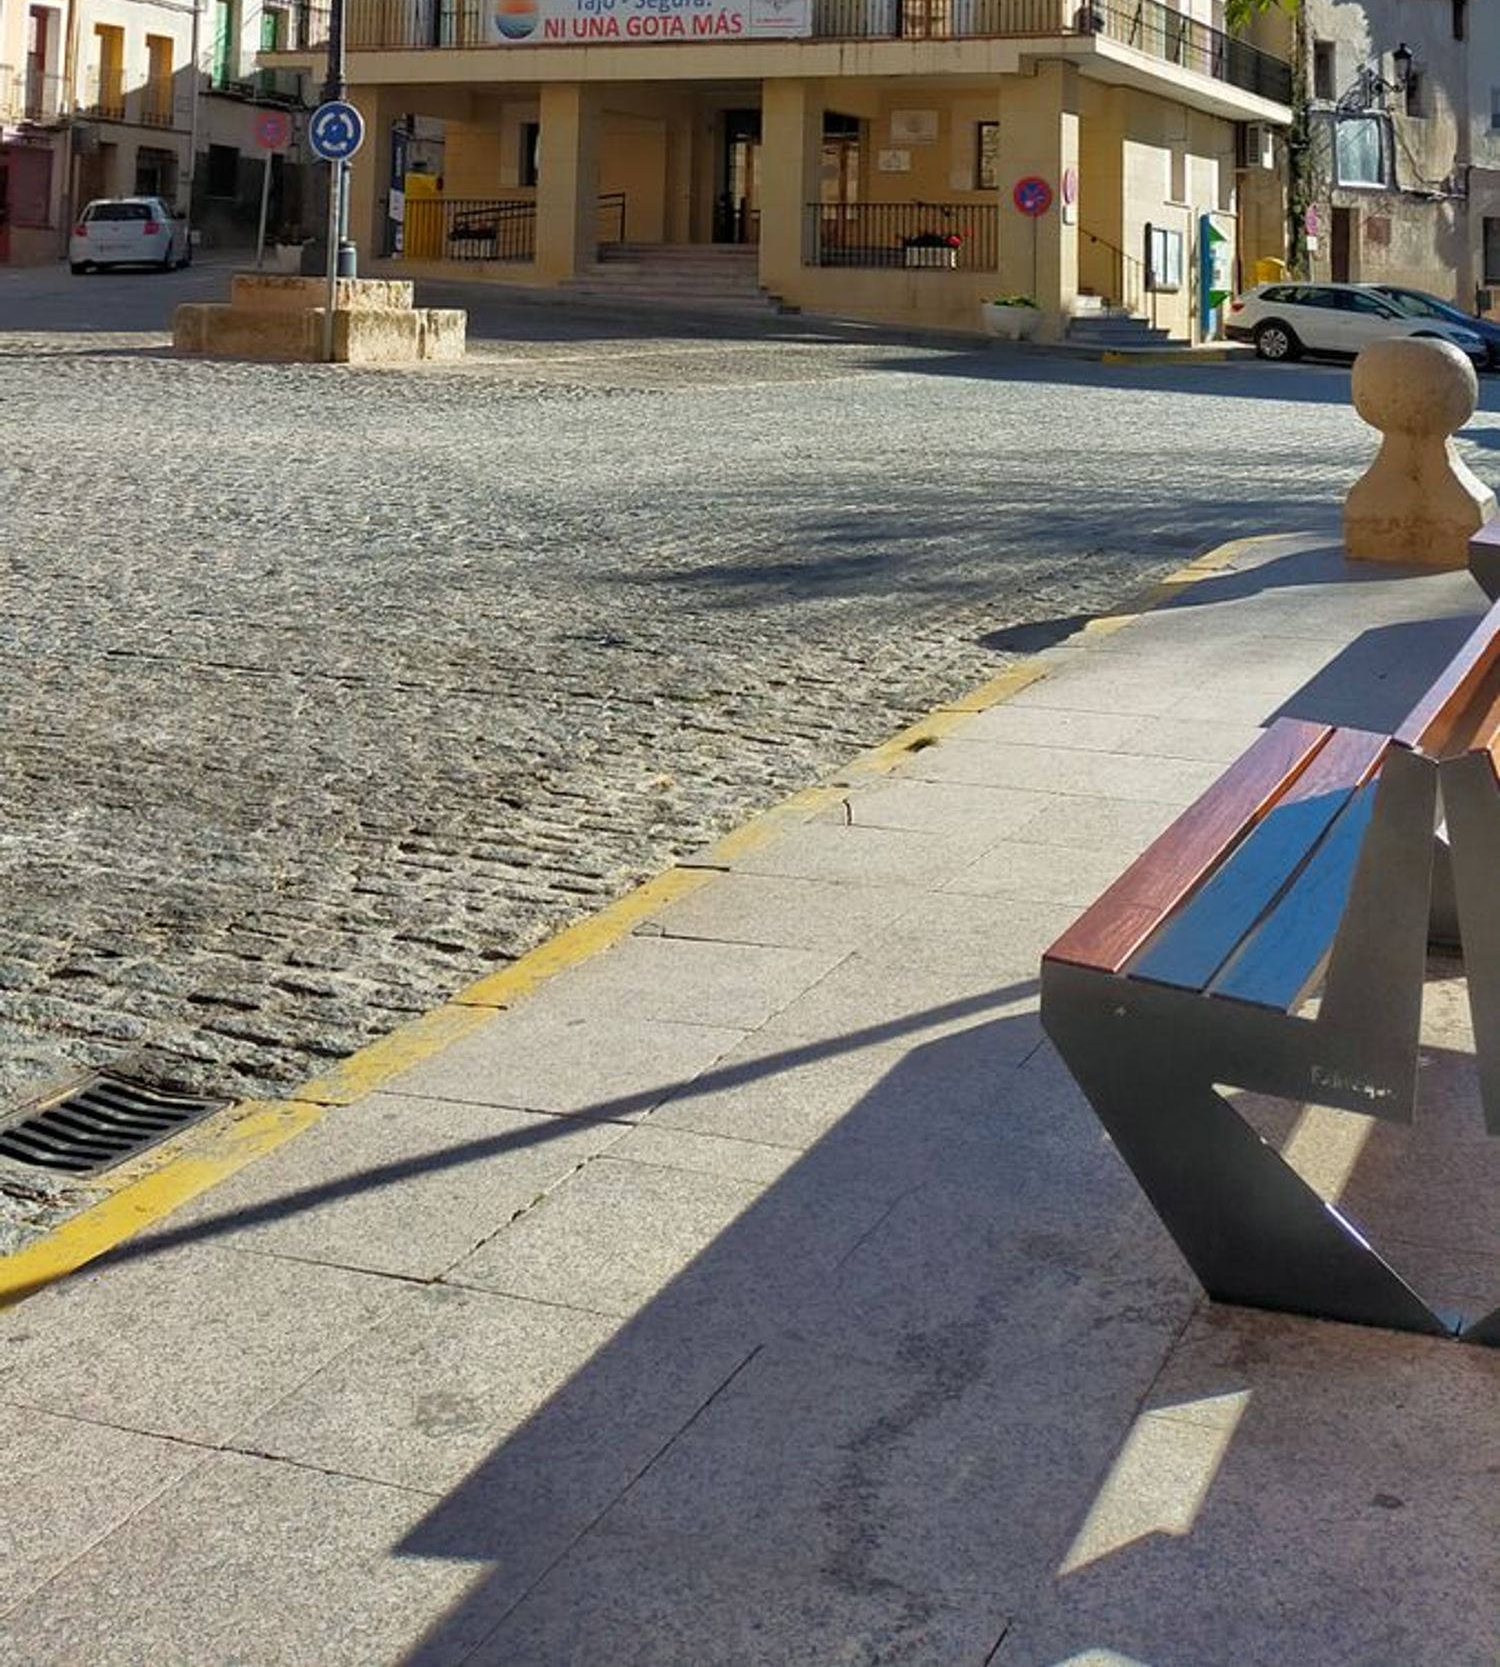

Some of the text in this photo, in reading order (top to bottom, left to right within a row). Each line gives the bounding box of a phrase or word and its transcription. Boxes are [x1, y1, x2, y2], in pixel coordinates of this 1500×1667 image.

[544, 8, 742, 38] NI UNA GOTA MÁS
